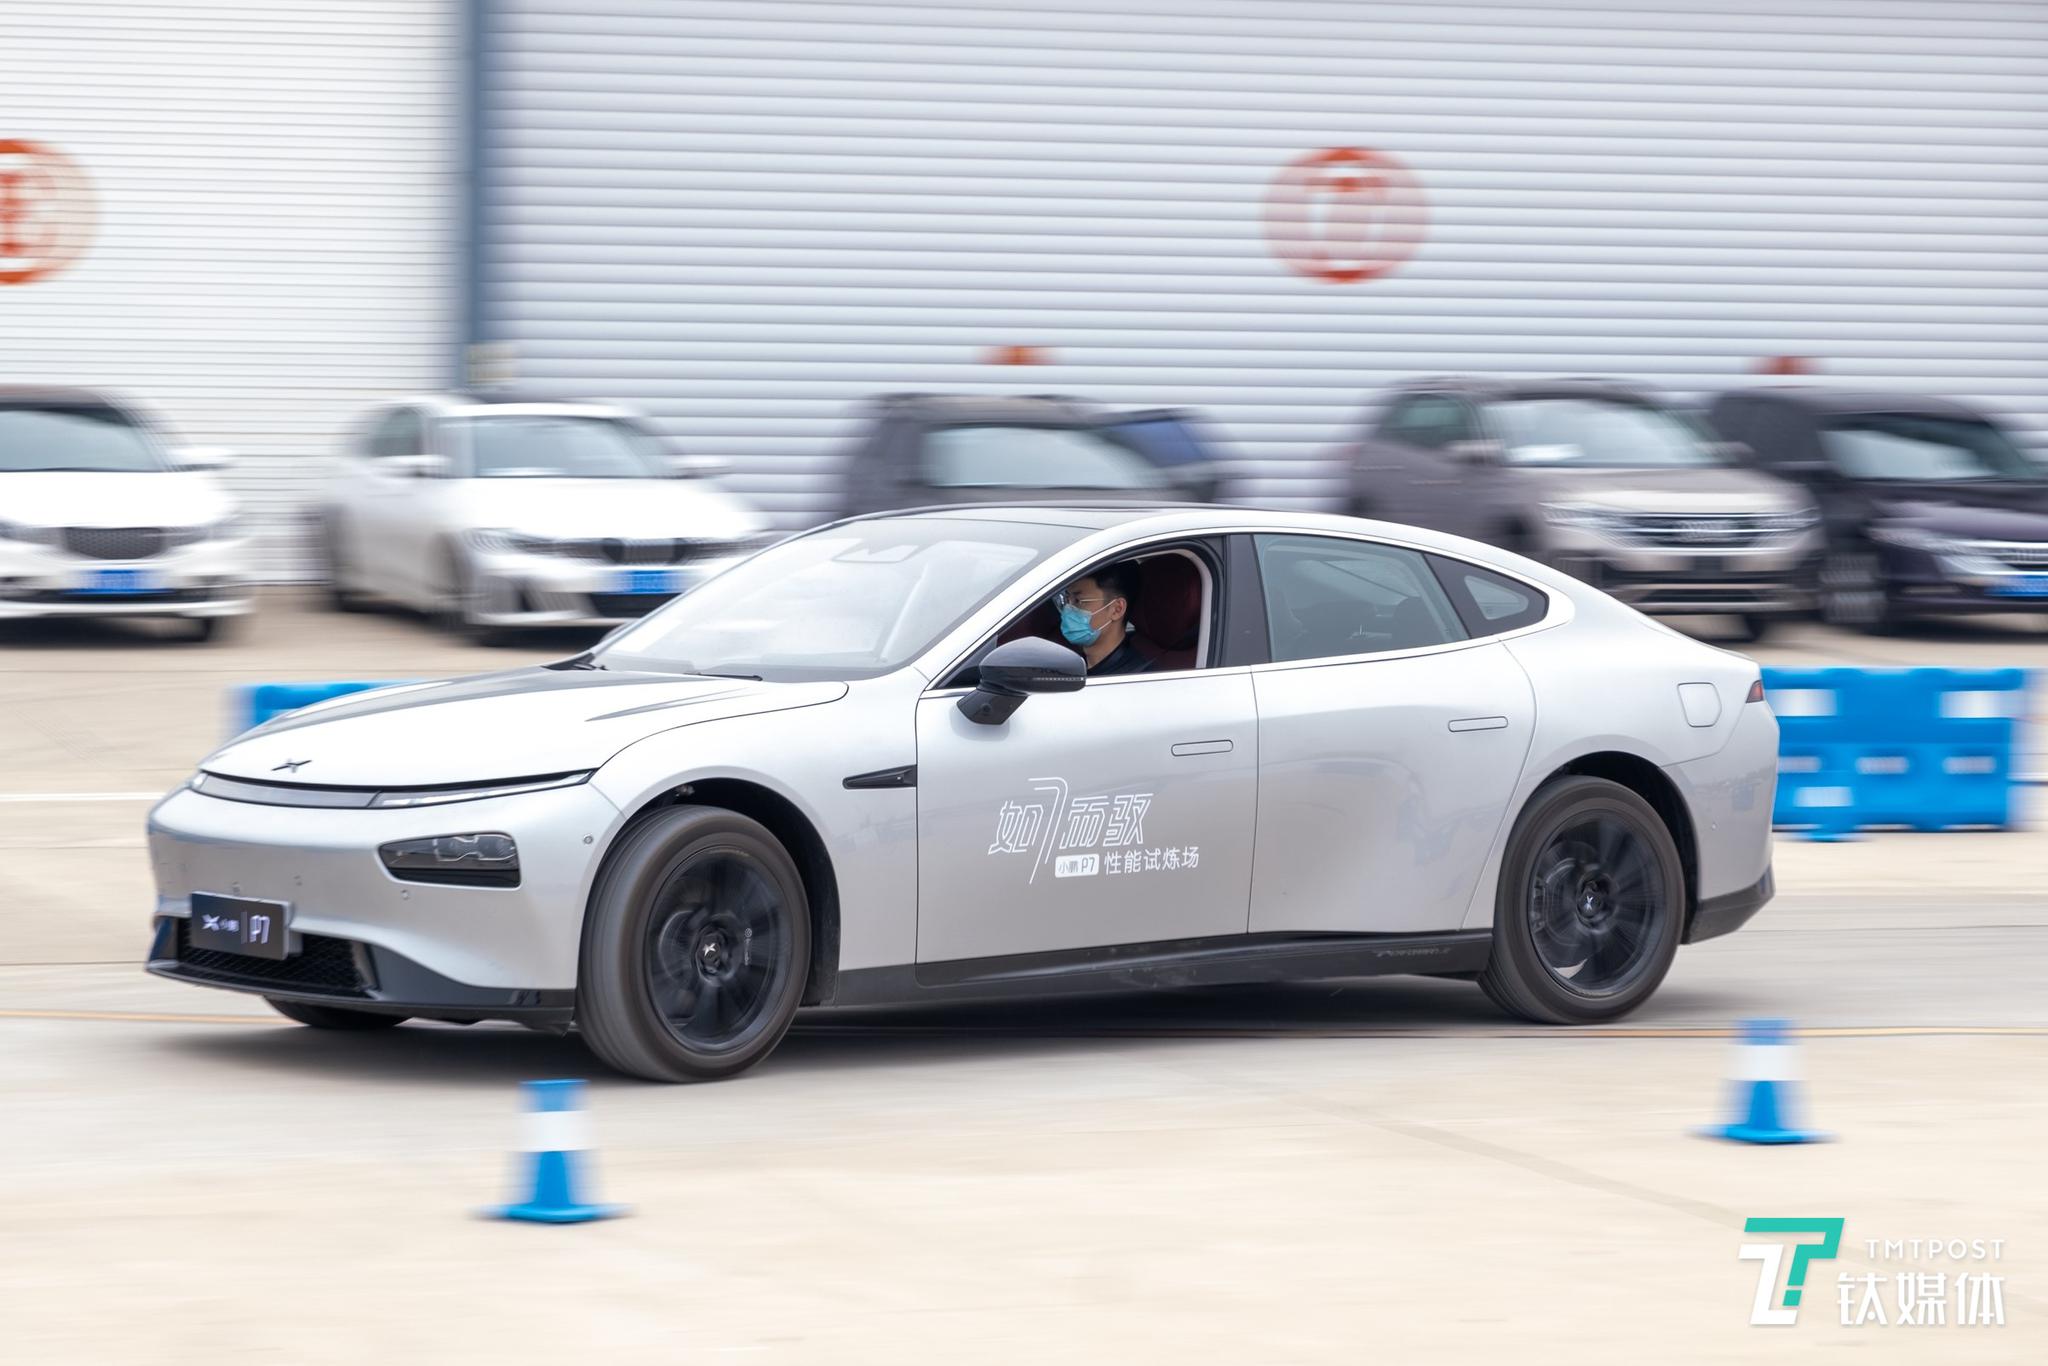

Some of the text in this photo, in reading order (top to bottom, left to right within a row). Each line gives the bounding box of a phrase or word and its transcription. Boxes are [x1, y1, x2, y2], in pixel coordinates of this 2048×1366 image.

[1081, 856, 1096, 873] P7
[1104, 846, 1199, 875] 性能试炼场
